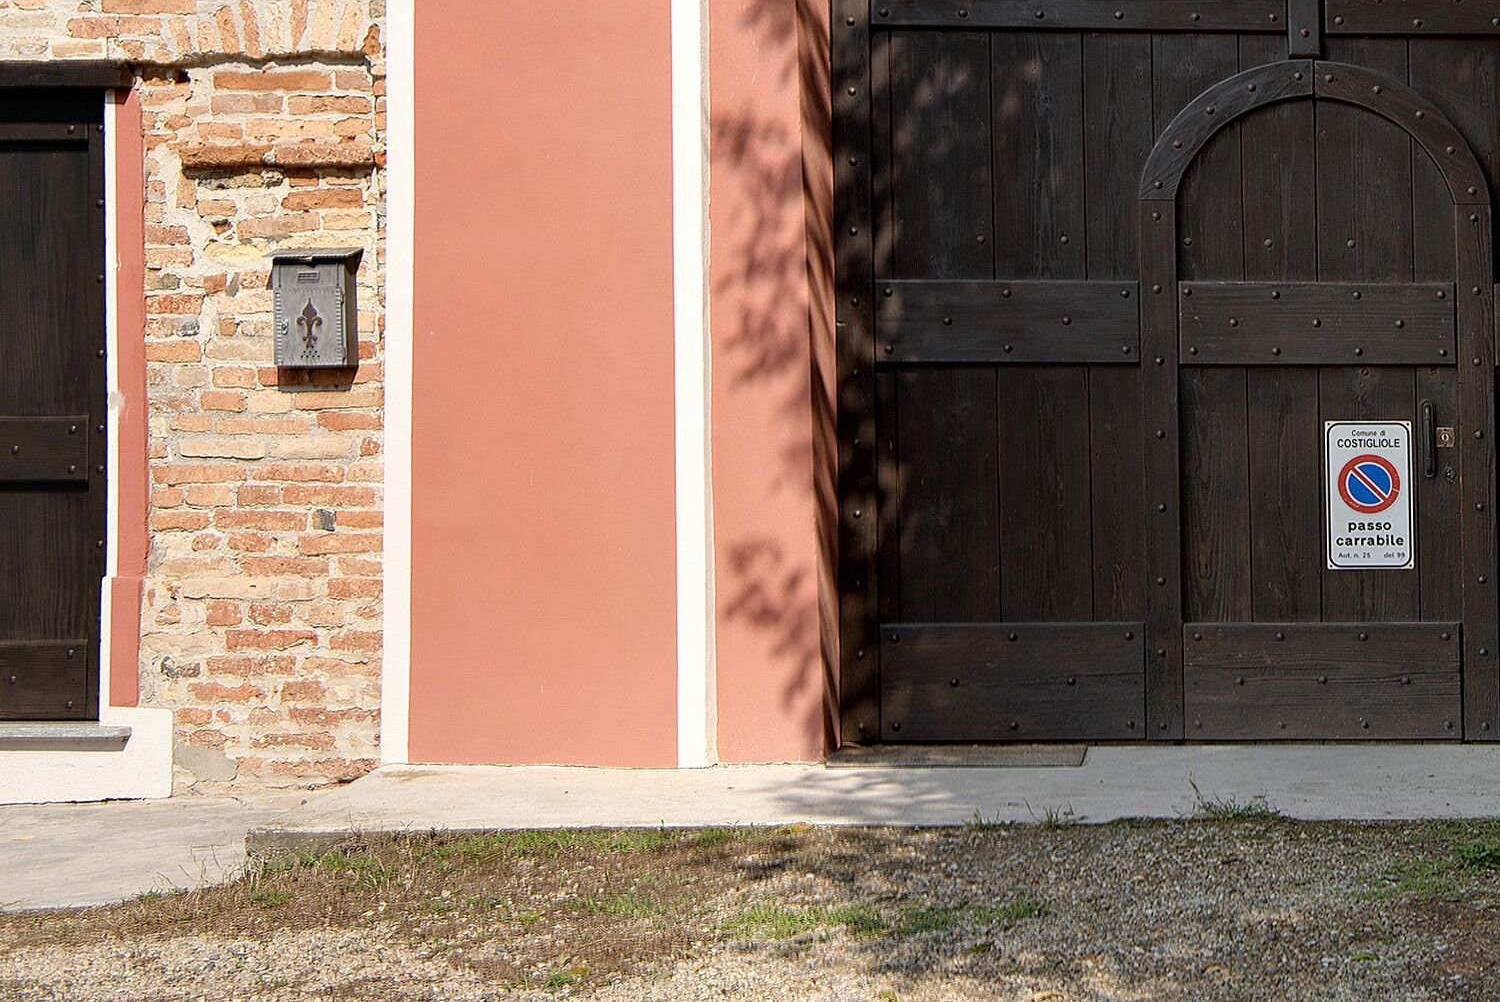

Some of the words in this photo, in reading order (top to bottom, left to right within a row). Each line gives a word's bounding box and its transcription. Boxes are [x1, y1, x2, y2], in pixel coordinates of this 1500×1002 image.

[1351, 429, 1377, 437] Comune
[1380, 429, 1386, 437] di
[1337, 438, 1400, 448] COSTIGLIOLE
[1348, 521, 1392, 533] passo
[1336, 534, 1404, 546] carrabile
